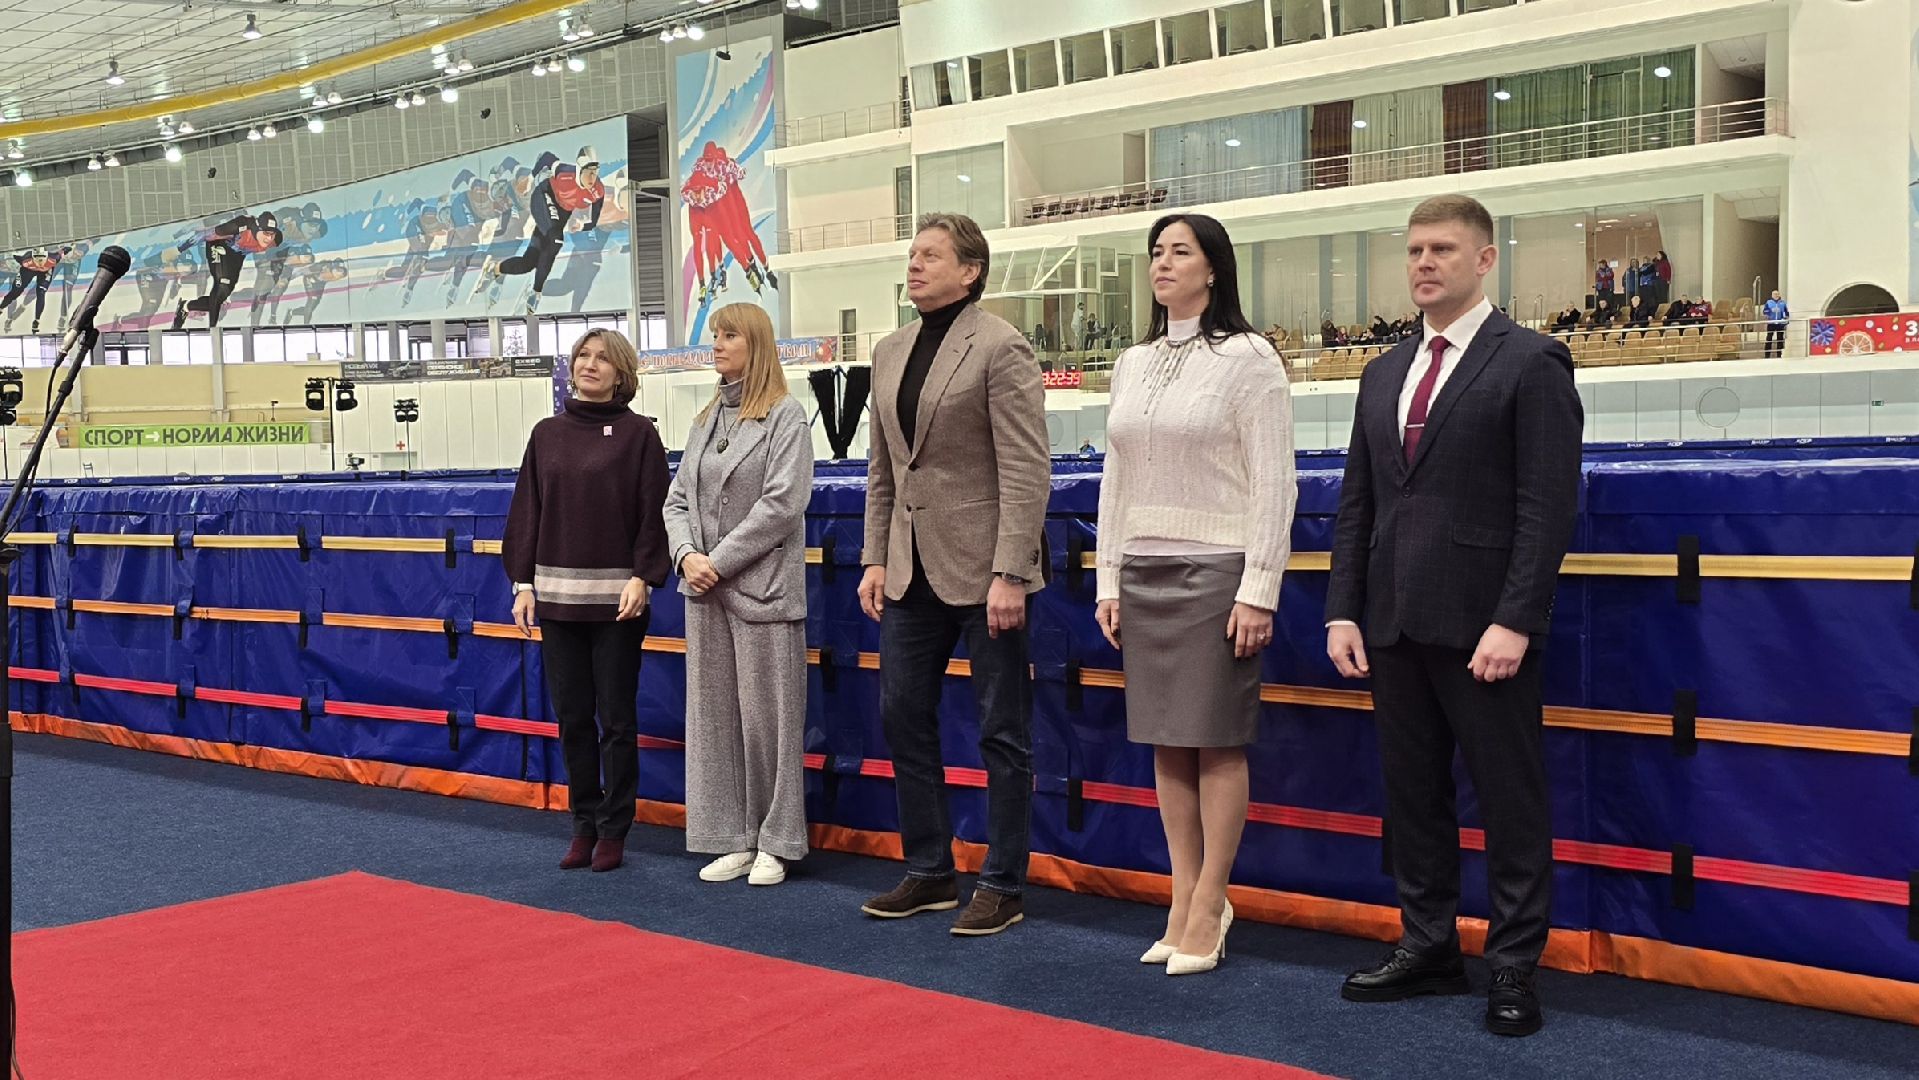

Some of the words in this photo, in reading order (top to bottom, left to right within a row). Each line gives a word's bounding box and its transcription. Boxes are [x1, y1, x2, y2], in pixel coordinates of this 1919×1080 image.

[84, 429, 145, 446] СПОРТ
[162, 426, 232, 444] НОРМА
[235, 425, 304, 443] ЖИЗНИ
